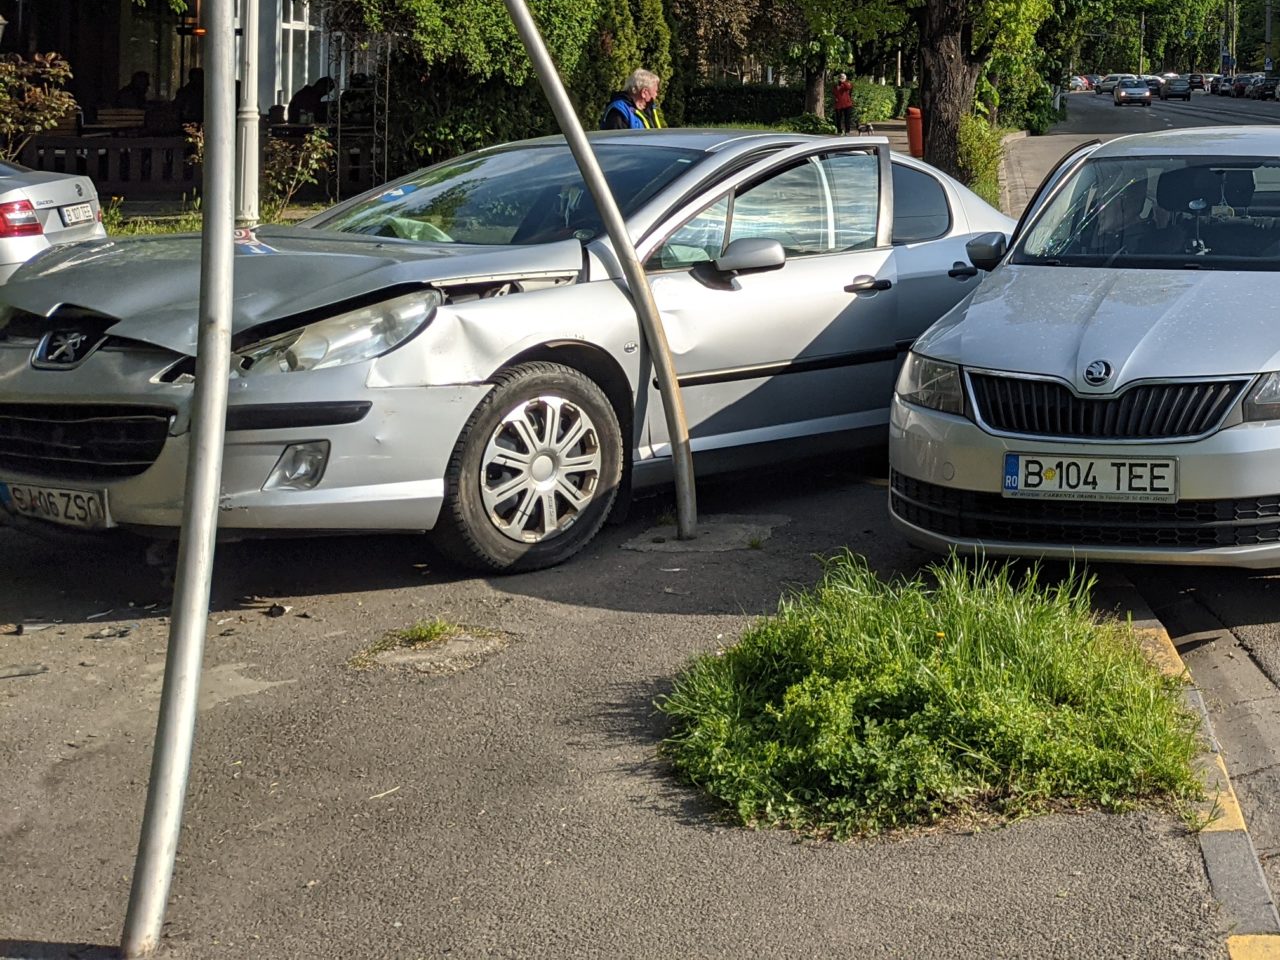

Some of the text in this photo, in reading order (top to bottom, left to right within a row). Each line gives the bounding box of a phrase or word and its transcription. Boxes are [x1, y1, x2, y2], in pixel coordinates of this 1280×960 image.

[1005, 475, 1018, 487] RO
[1024, 459, 1170, 492] B 104 TEE
